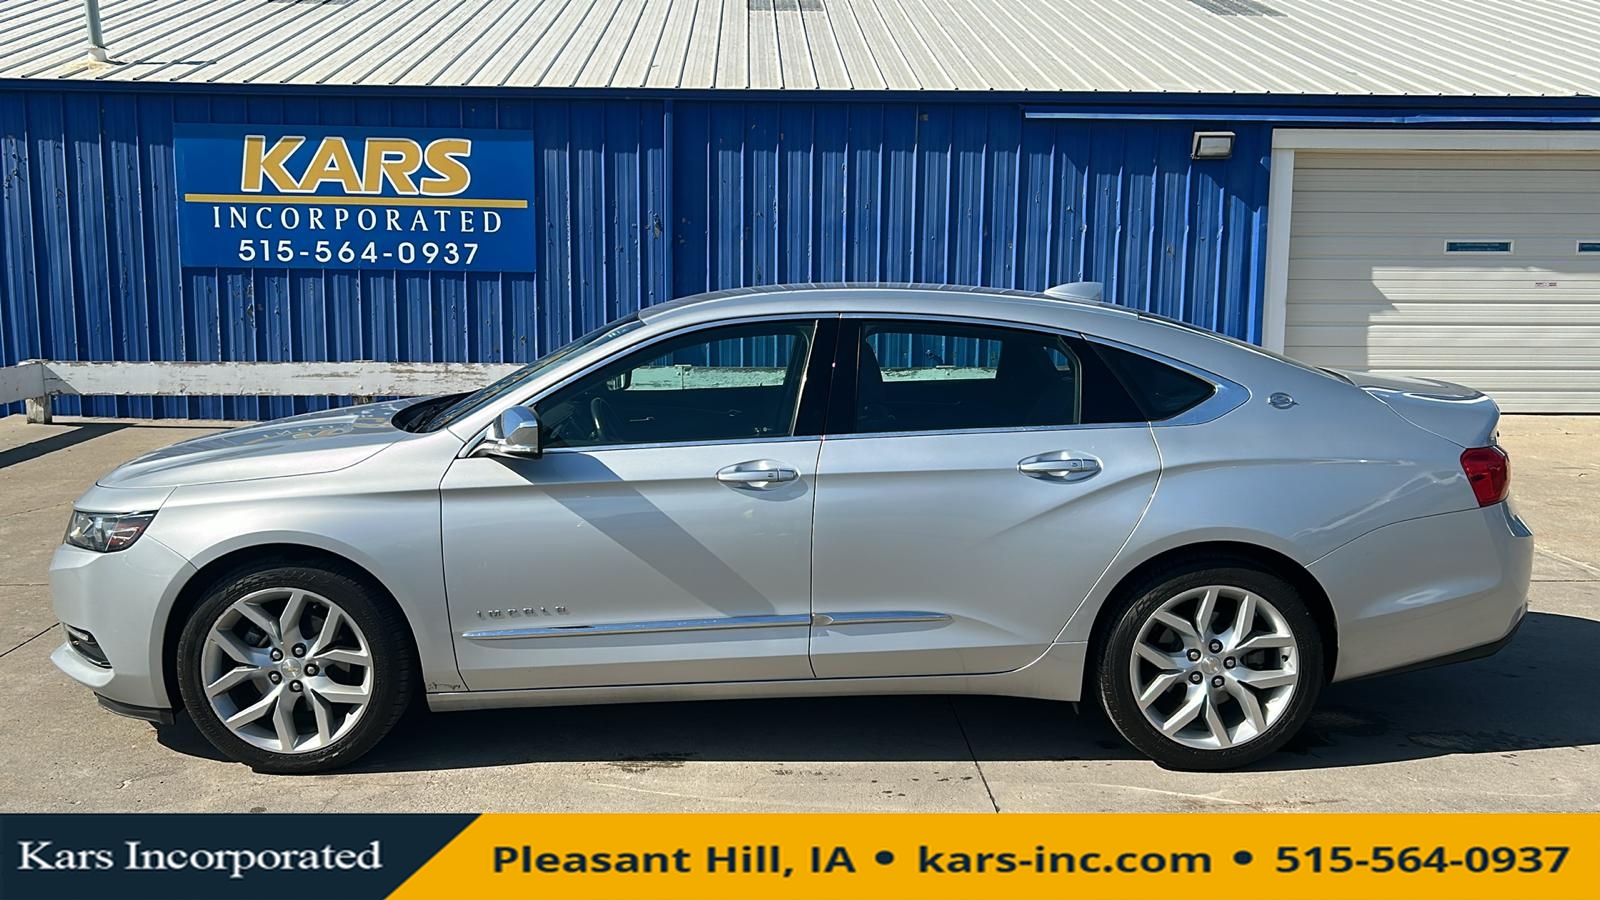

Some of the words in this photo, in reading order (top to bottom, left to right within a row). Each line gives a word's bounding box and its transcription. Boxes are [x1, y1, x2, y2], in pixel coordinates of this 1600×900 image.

[241, 134, 472, 196] KARS
[212, 205, 502, 234] INCORPORATED
[238, 239, 479, 265] 515-564-0937
